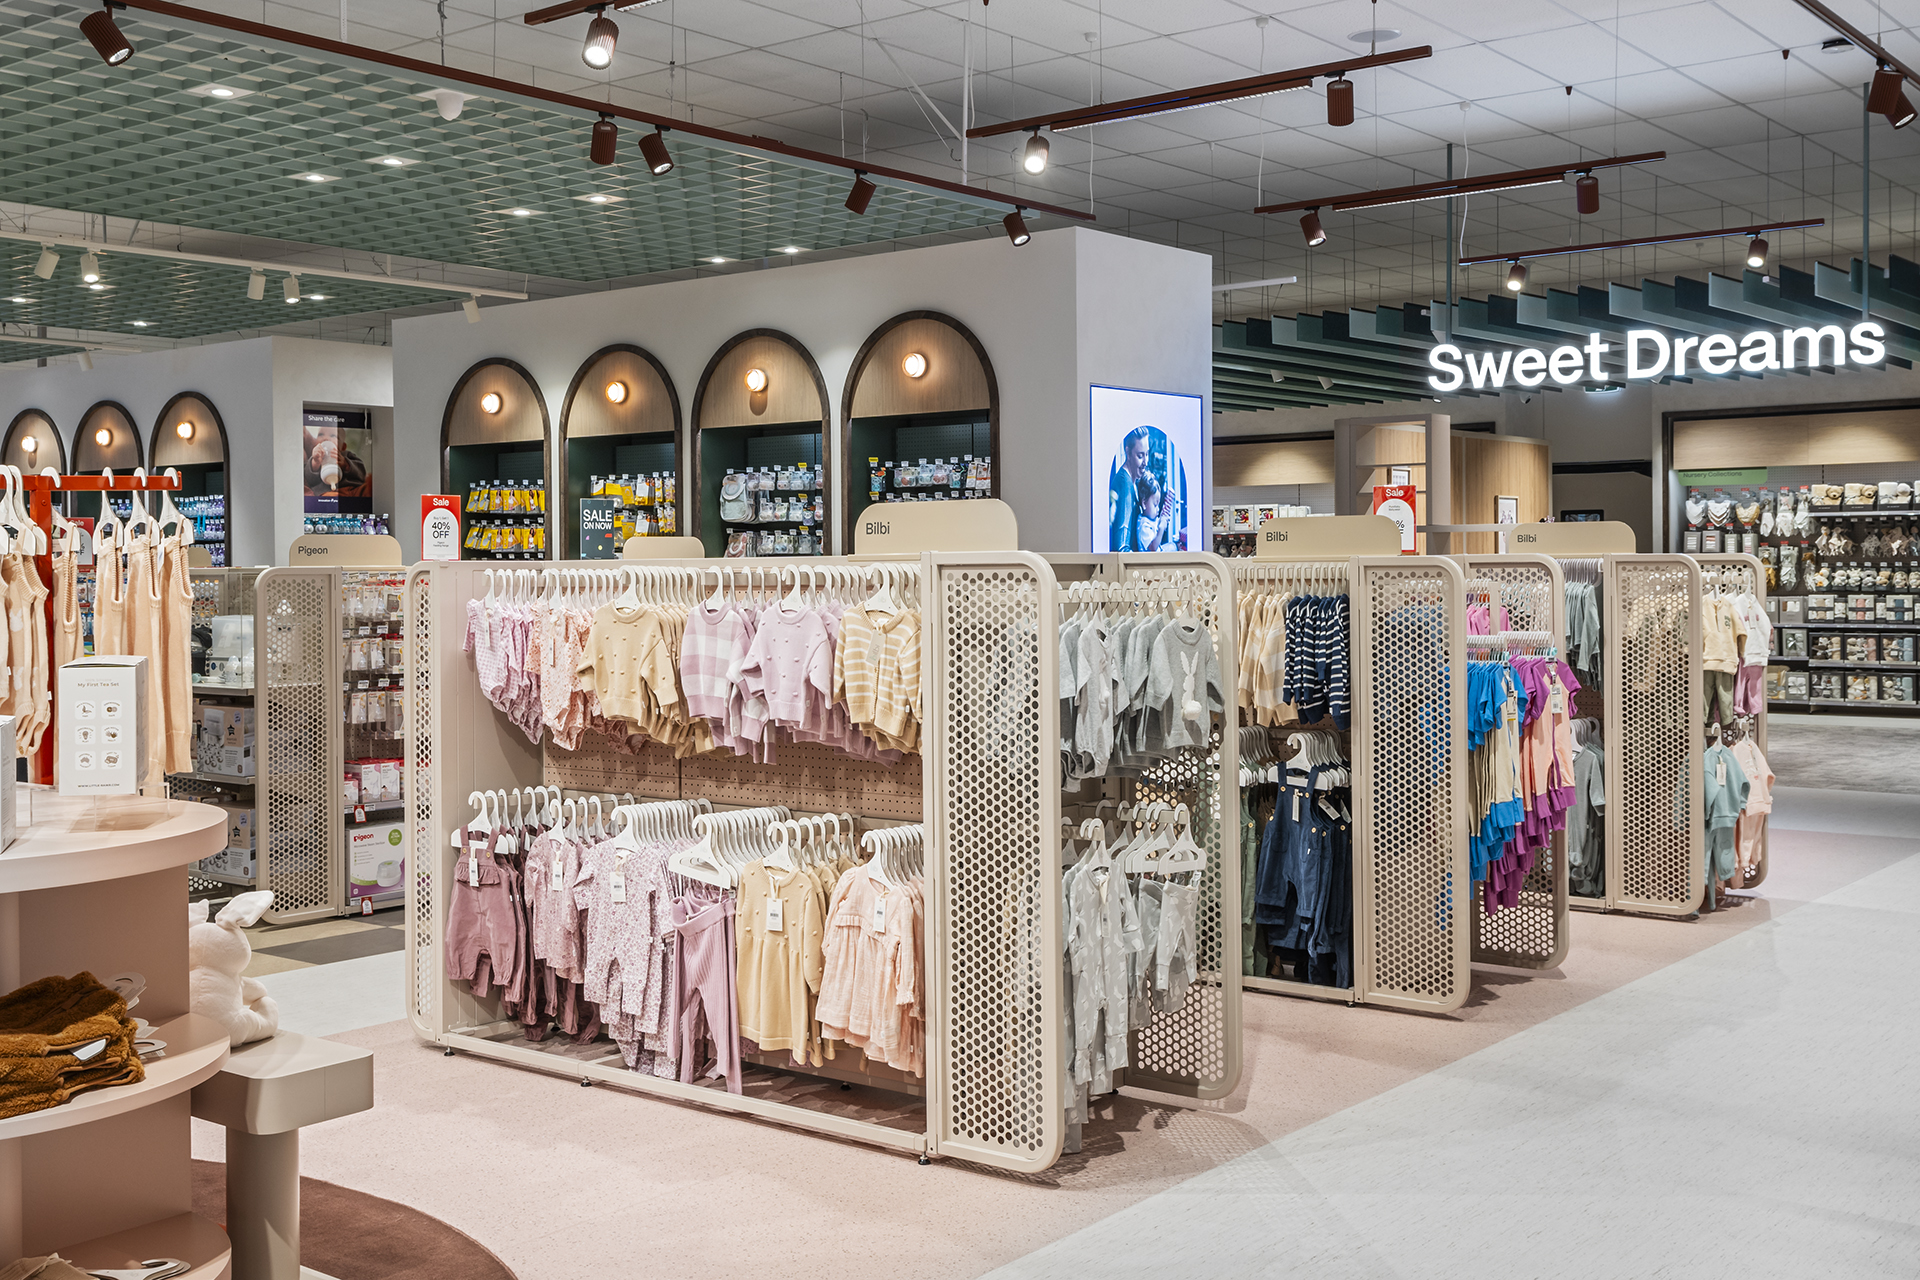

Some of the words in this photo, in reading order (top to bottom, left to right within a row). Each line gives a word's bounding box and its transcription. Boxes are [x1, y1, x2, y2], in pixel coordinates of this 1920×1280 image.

[1427, 332, 1609, 392] Sweet
[1626, 321, 1886, 379] Dreams
[1385, 488, 1405, 497] Sale
[433, 498, 450, 506] Sale
[583, 509, 613, 522] SALE
[432, 522, 451, 530] 40%
[583, 522, 594, 530] ON
[594, 522, 612, 530] NOW
[866, 521, 890, 535] Bilbi
[432, 530, 449, 538] OFF
[1266, 531, 1288, 542] Bilbi
[1517, 534, 1537, 543] Bilbi
[298, 546, 328, 556] Pigeon
[354, 833, 374, 842] pigeon
